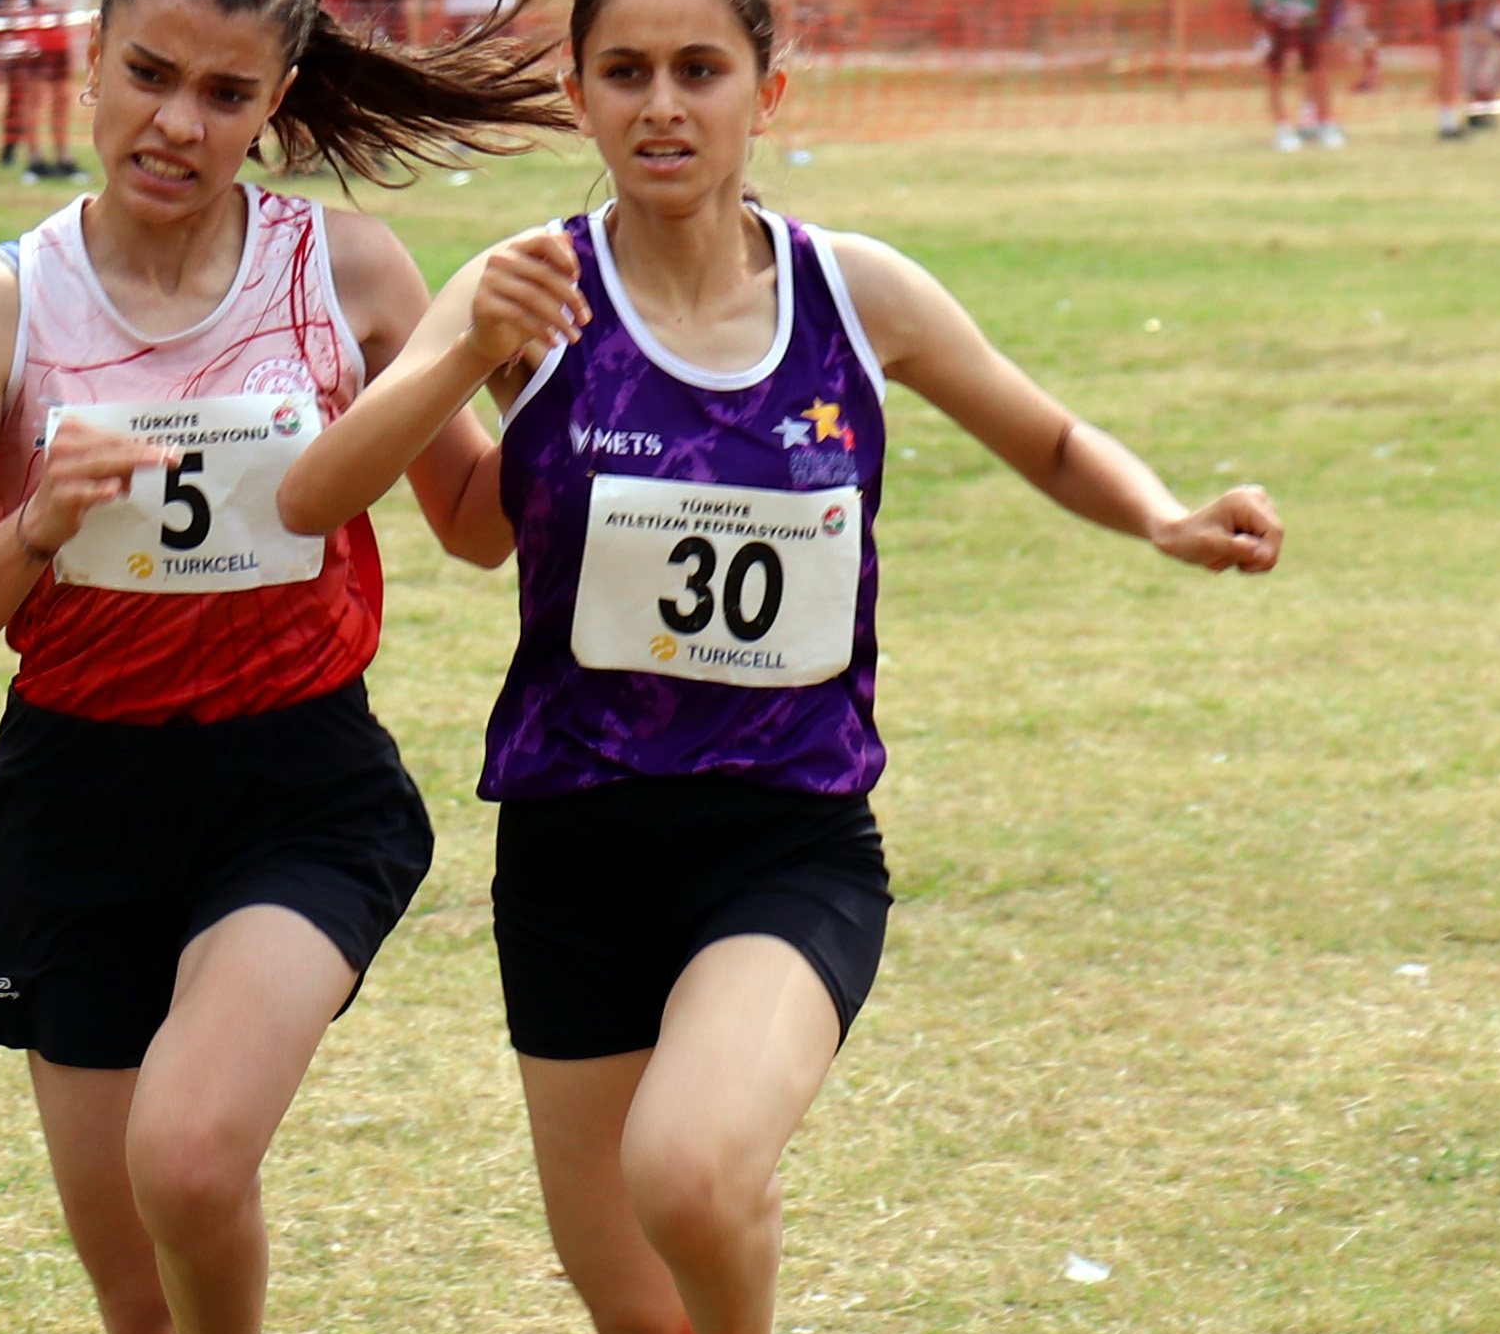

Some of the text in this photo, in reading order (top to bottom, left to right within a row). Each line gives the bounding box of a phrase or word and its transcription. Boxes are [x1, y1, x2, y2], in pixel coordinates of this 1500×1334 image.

[130, 412, 199, 431] TÜRKİYE
[160, 451, 211, 550] 5
[679, 498, 752, 517] TÜRKİYE
[605, 511, 818, 541] ATLETİZM FEDERASYONU
[162, 551, 259, 575] TURKCELL
[658, 536, 783, 642] 30
[687, 643, 786, 669] TURKCELL
